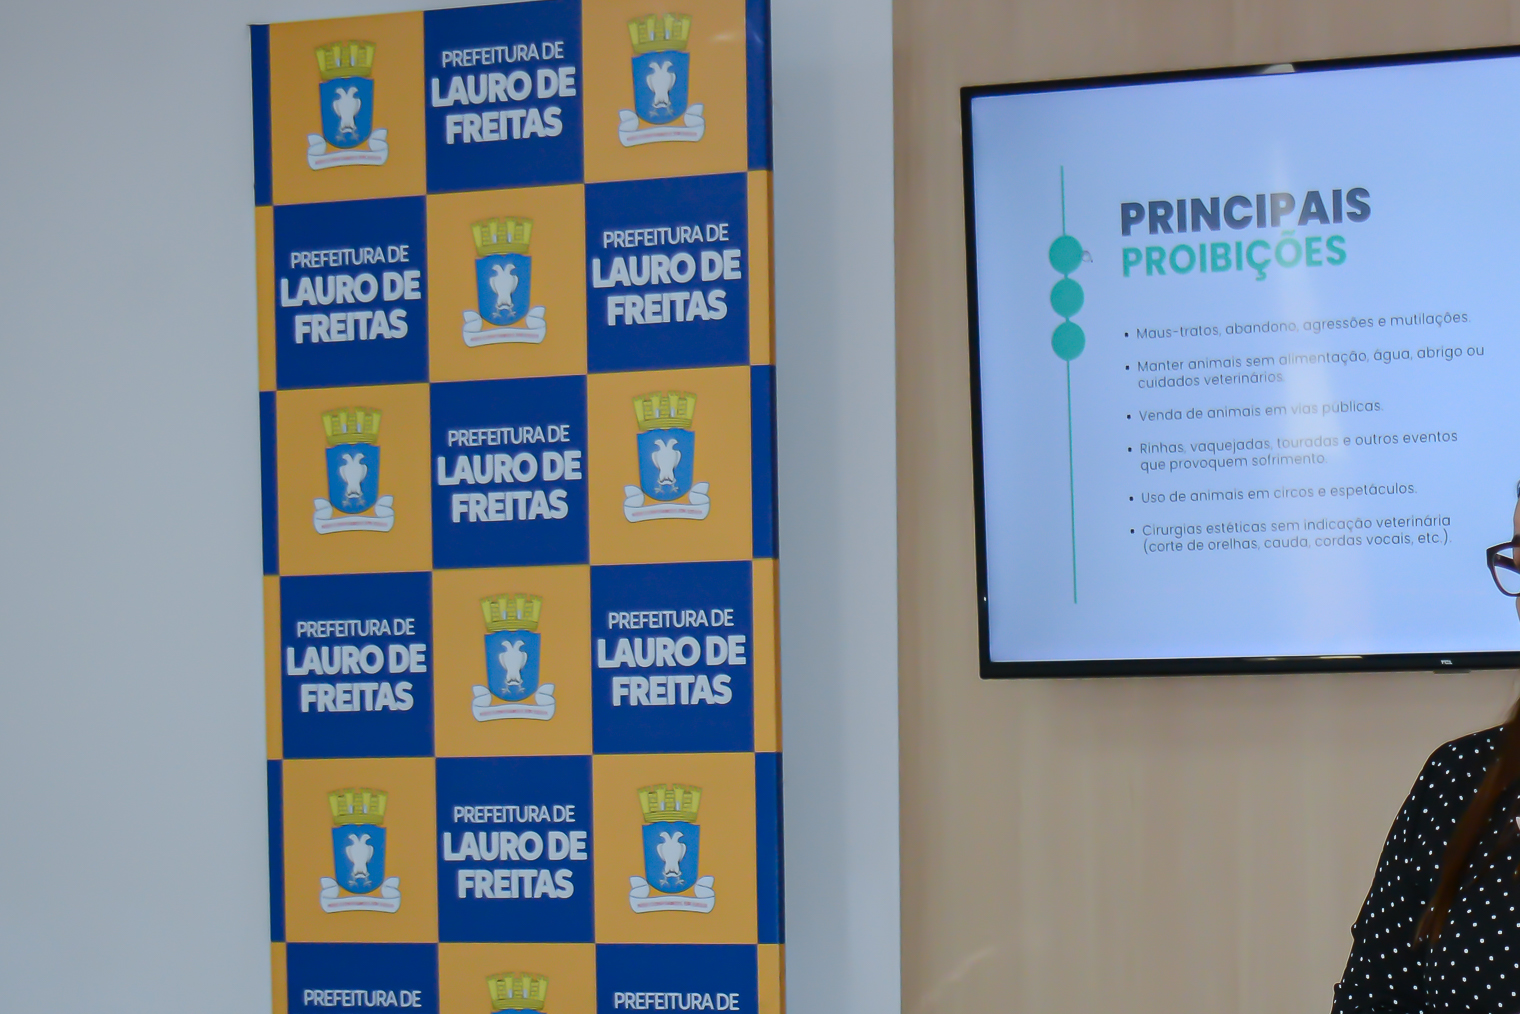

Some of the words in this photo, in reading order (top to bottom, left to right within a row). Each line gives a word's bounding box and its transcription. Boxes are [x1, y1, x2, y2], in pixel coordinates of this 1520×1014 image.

[441, 44, 540, 67] PREFEITURA
[541, 41, 565, 60] DE
[431, 71, 533, 108] LAURO
[537, 67, 577, 98] DE
[445, 106, 563, 145] FREITAS
[1121, 187, 1371, 236] PRINCIPAIS
[602, 226, 704, 249] PREFEITURA
[705, 224, 730, 243] DE
[290, 247, 386, 269] PREFEITURA
[387, 245, 410, 264] DE
[591, 252, 697, 289] LAURO
[701, 249, 742, 282] DE
[1123, 230, 1347, 281] PROIBIÇÕES
[280, 273, 379, 308] LAURO
[383, 270, 422, 302] DE
[606, 289, 728, 327] FREITAS
[294, 309, 409, 345] FREITAS
[1136, 326, 1222, 340] Maus-tratos,
[1224, 320, 1299, 335] abandono,
[1303, 316, 1374, 335] agressões
[1377, 316, 1387, 328] e
[1390, 311, 1471, 329] mutilações.
[1137, 359, 1185, 373] Manter
[1188, 355, 1242, 370] animais
[1245, 356, 1275, 368] sem
[1373, 347, 1414, 365] água,
[1417, 345, 1463, 362] abrigo
[1466, 345, 1485, 357] ou
[1137, 374, 1201, 389] cuidados
[1138, 408, 1184, 422] Venda
[1185, 407, 1203, 420] de
[1206, 405, 1262, 419] animais
[1264, 405, 1287, 417] em
[447, 426, 546, 447] PREFEITURA
[547, 425, 571, 443] DE
[1189, 437, 1273, 456] vaquejadas,
[1276, 435, 1339, 449] touradas
[1342, 436, 1352, 447] e
[1354, 434, 1399, 446] outros
[1402, 430, 1458, 444] eventos
[436, 452, 538, 486] LAURO
[542, 450, 583, 482] DE
[1140, 460, 1166, 475] que
[1169, 456, 1248, 474] provoquem
[1251, 452, 1328, 467] sofrimento.
[451, 489, 569, 524] FREITAS
[1140, 490, 1167, 504] Uso
[1168, 489, 1187, 503] de
[1189, 487, 1244, 502] animais
[1247, 489, 1270, 500] em
[1273, 486, 1315, 499] circos
[1317, 487, 1327, 498] e
[1329, 481, 1418, 500] espetáculos.
[1141, 522, 1203, 540] Cirurgias
[1205, 520, 1267, 536] estéticas
[1270, 521, 1300, 532] sem
[1303, 516, 1373, 533] indicação
[1375, 513, 1452, 529] veterinária
[1142, 539, 1184, 556] (corte
[1186, 538, 1205, 552] de
[1207, 536, 1261, 552] orelhas,
[1263, 535, 1311, 549] cauda,
[1314, 534, 1363, 548] cordas
[1365, 532, 1414, 546] vocais,
[296, 619, 392, 638] PREFEITURA
[393, 618, 416, 636] DE
[608, 610, 709, 630] PREFEITURA
[710, 609, 735, 627] DE
[286, 644, 385, 676] LAURO
[388, 644, 427, 674] DE
[597, 636, 701, 669] LAURO
[705, 635, 747, 666] DE
[300, 681, 414, 713] FREITAS
[611, 674, 733, 707] FREITAS
[453, 805, 552, 824] PREFEITURA
[553, 805, 576, 823] DE
[442, 831, 544, 862] LAURO
[548, 830, 588, 861] DE
[457, 868, 575, 899] FREITAS
[303, 989, 399, 1008] PREFEITURA
[400, 990, 422, 1008] DE
[614, 992, 715, 1011] PREFEITURA
[716, 993, 740, 1011] DE
